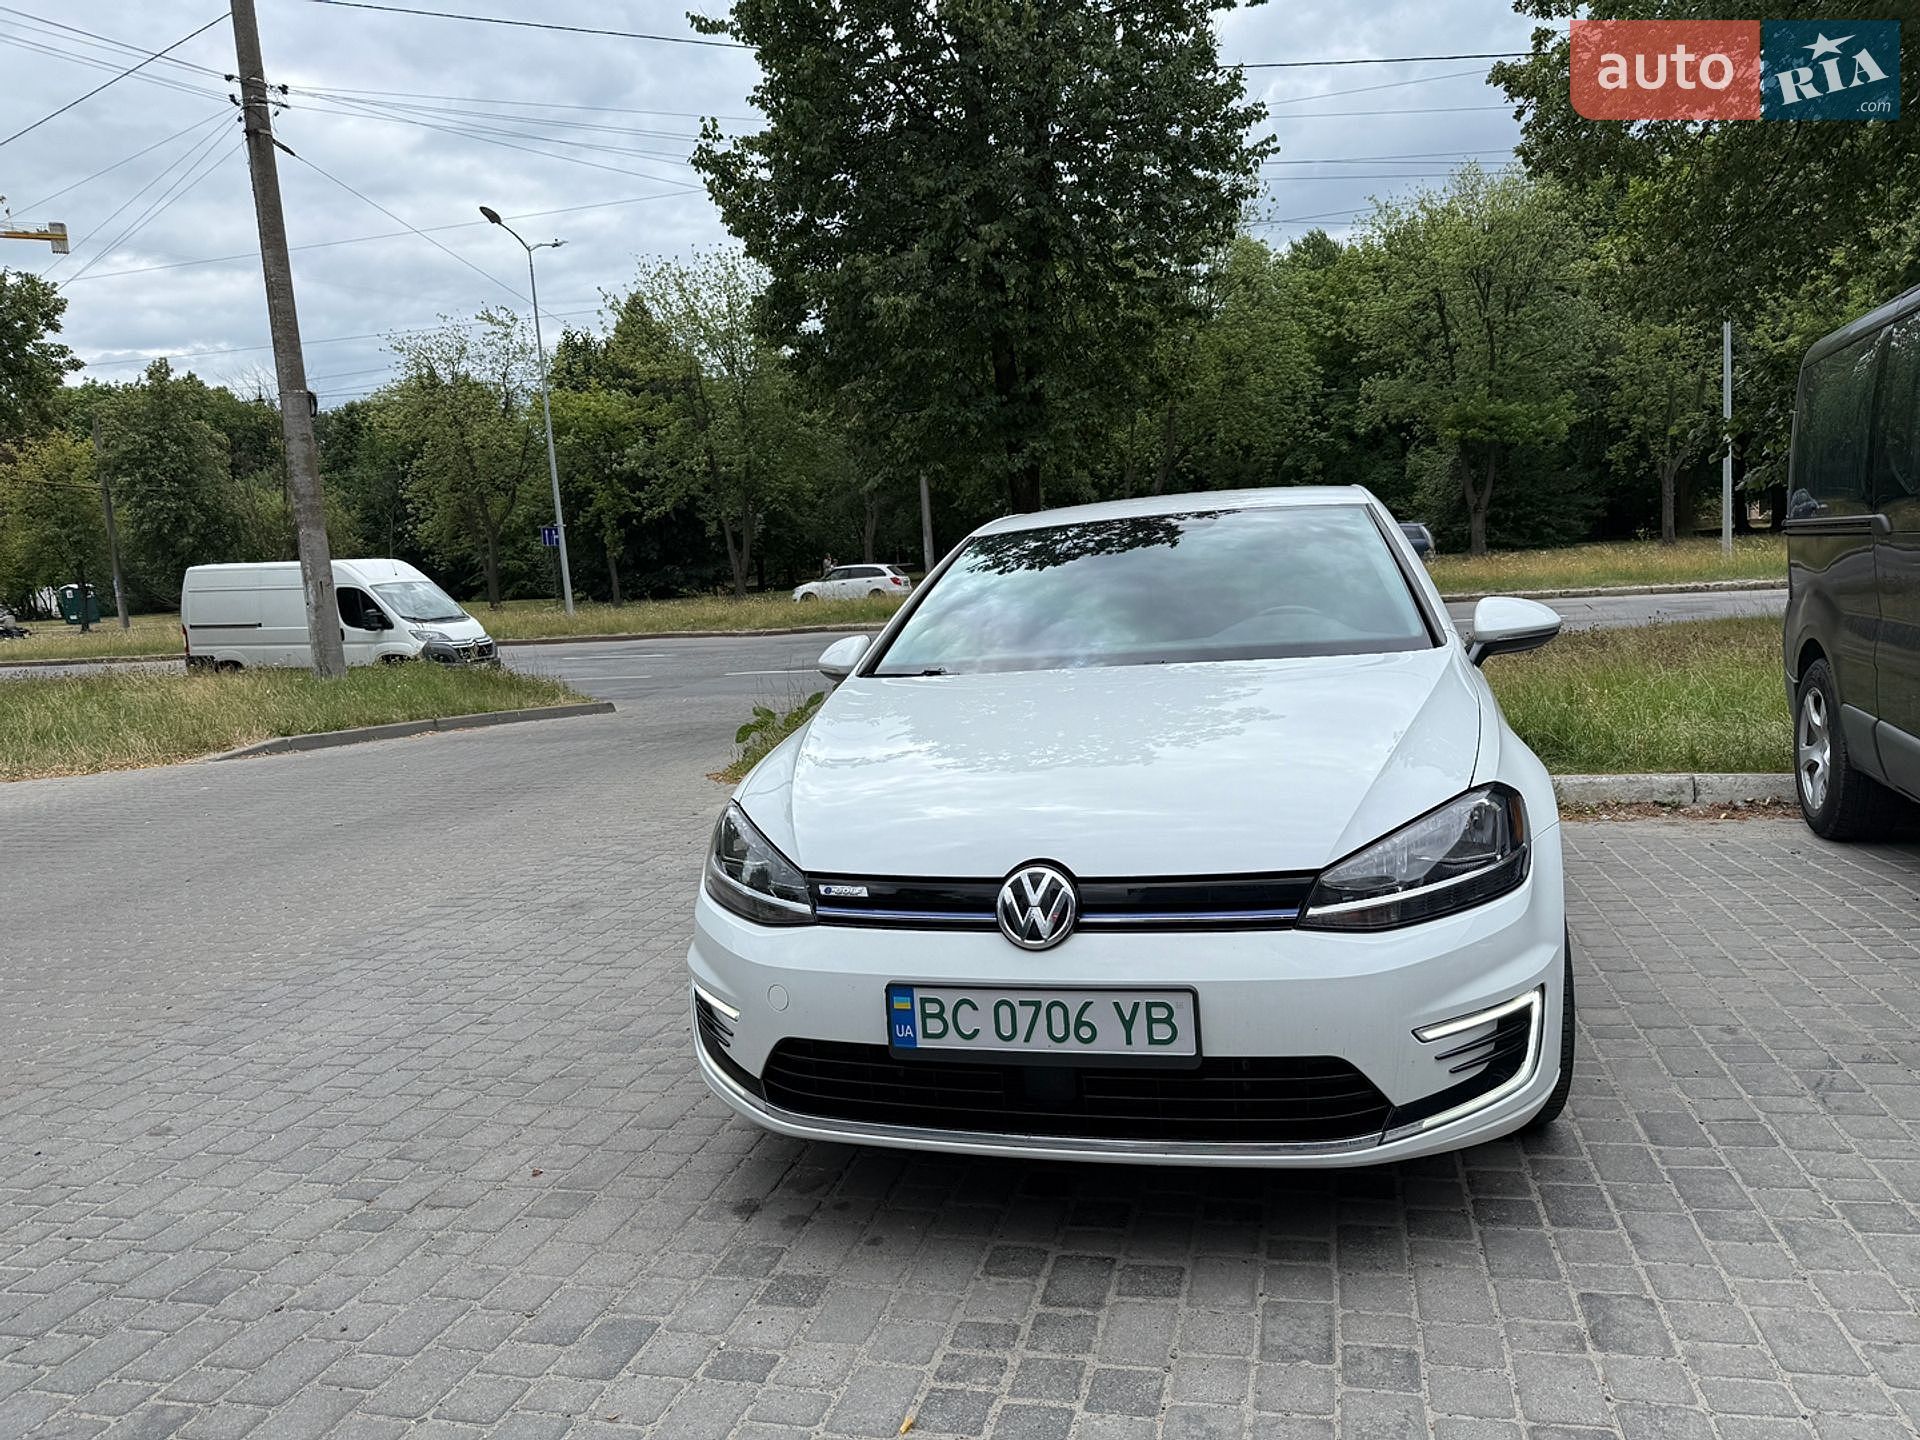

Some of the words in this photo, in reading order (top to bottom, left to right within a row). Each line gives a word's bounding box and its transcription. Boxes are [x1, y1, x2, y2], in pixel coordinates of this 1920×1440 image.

[896, 1024, 914, 1038] UA
[919, 997, 980, 1040] BC
[993, 998, 1098, 1044] 0706
[1112, 1001, 1179, 1046] YB
